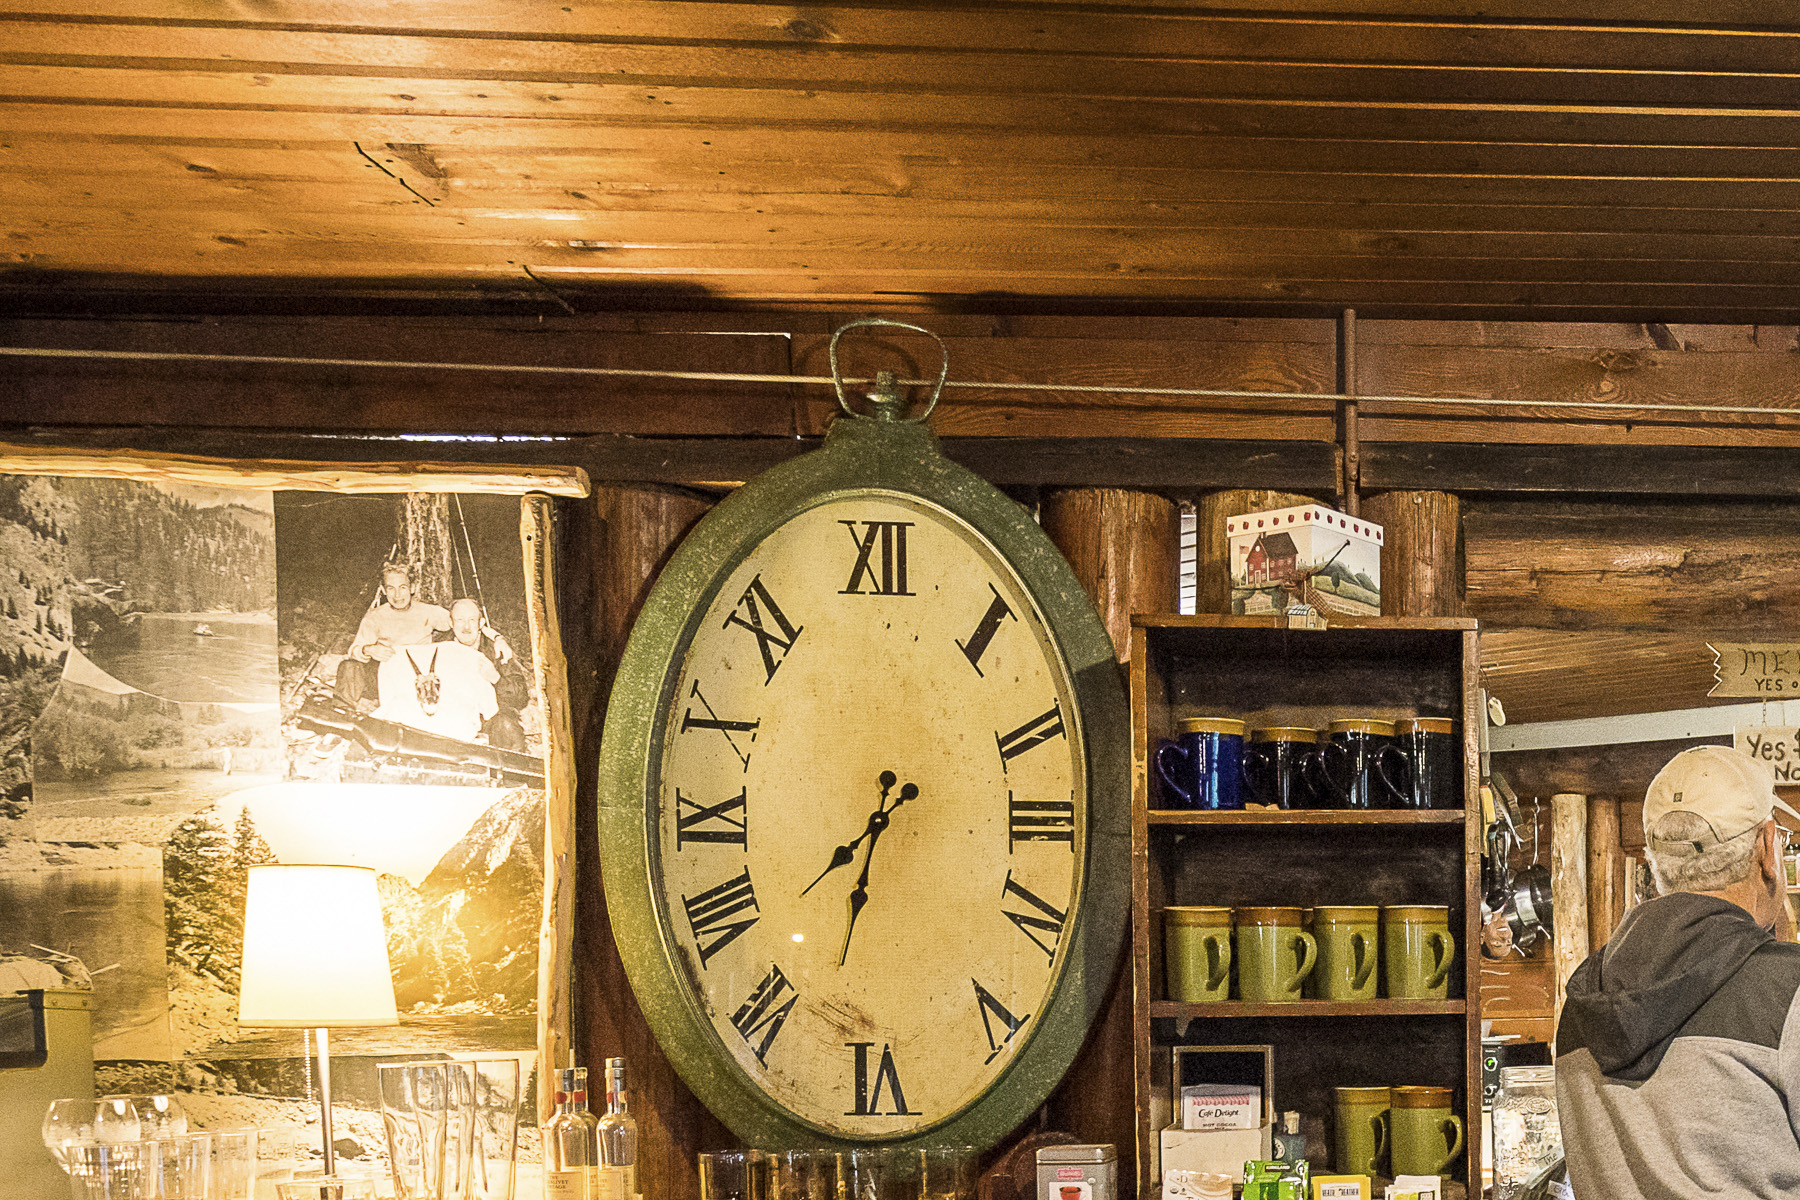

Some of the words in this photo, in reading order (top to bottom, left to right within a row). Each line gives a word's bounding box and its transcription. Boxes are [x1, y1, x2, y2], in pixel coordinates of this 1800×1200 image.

[837, 520, 917, 596] XII
[722, 573, 804, 687] XI
[955, 582, 1018, 678] I
[681, 679, 761, 773] X
[1754, 678, 1784, 692] YES
[995, 698, 1067, 774] II
[1747, 734, 1785, 761] Yes
[676, 786, 747, 852] IX
[1008, 790, 1076, 855] III
[681, 865, 760, 971] VIII
[1000, 868, 1069, 968] IV
[726, 961, 800, 1070] VII
[971, 977, 1031, 1065] V
[844, 1042, 922, 1116] VI
